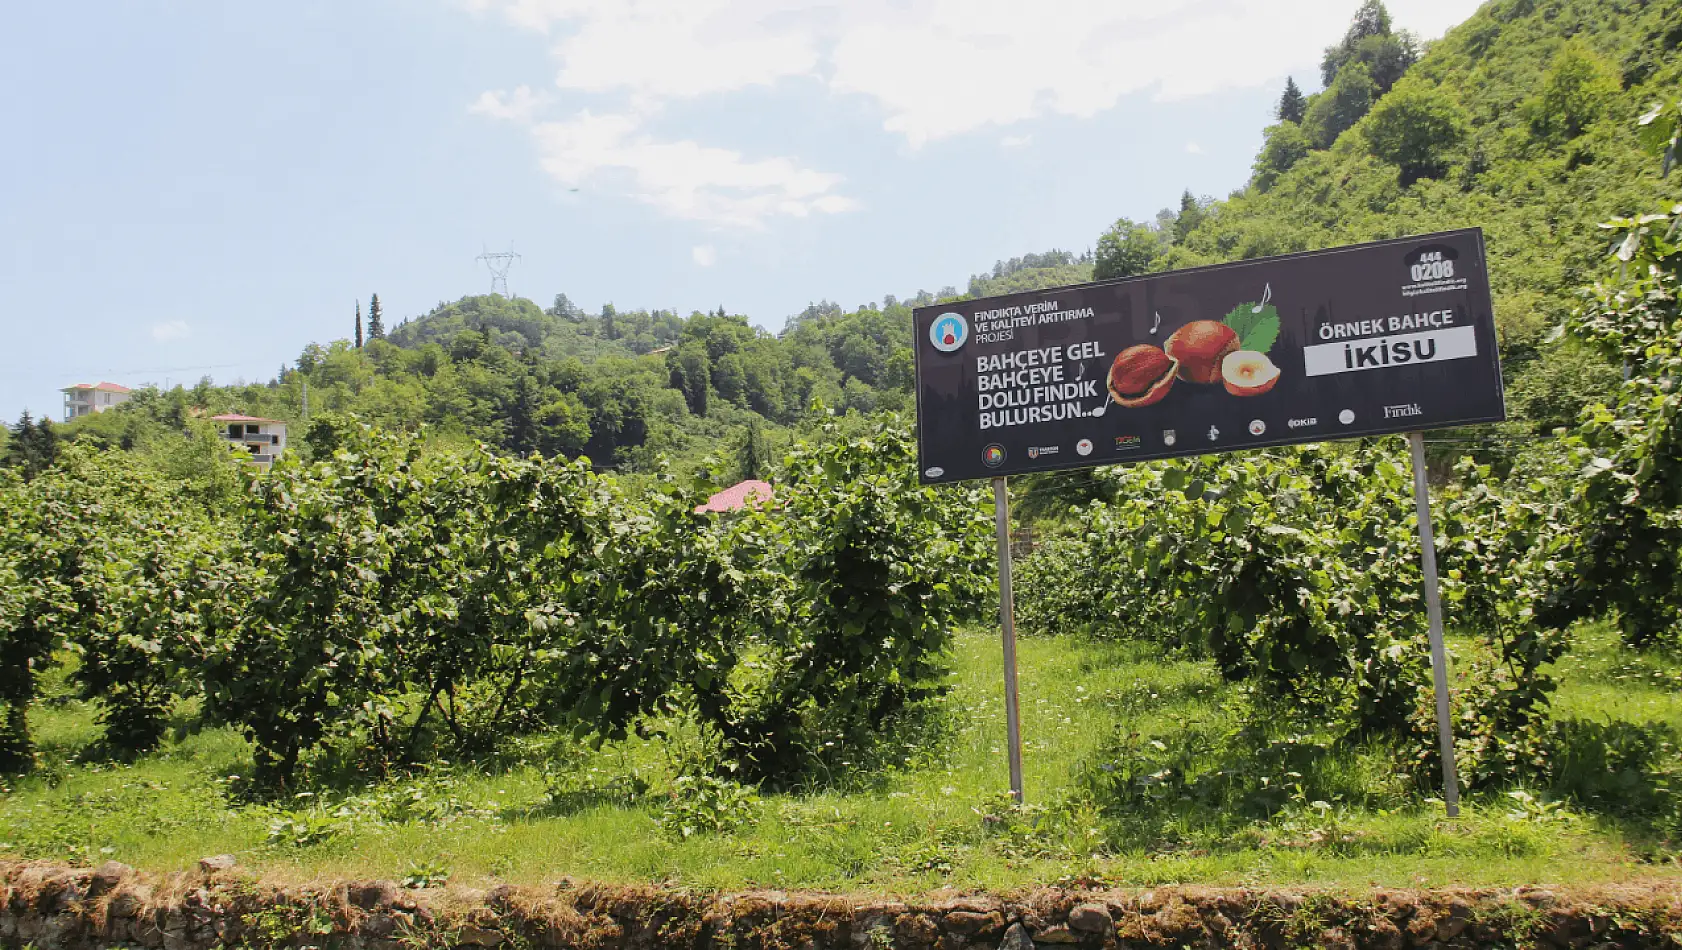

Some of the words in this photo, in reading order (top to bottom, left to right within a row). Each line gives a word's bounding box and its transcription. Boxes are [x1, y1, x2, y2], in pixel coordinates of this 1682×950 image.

[1420, 251, 1442, 262] 444
[1411, 260, 1454, 282] 0208
[974, 305, 1022, 322] FINDIKTA
[1023, 300, 1058, 315] VERİM
[975, 321, 989, 333] VE
[990, 313, 1036, 331] KALİTEYİ
[1038, 307, 1095, 325] ARTTIRMA
[975, 328, 1014, 344] PROJESİ
[1319, 317, 1384, 340] ÖRNEK
[1388, 309, 1453, 332] BAHÇE
[976, 346, 1063, 373] BAHÇEYE
[1066, 341, 1105, 361] GEL
[1344, 338, 1436, 369] İKİSU
[977, 365, 1065, 391] BAHÇEYE
[978, 387, 1030, 410] DOLU
[1033, 379, 1099, 404] FINDIK
